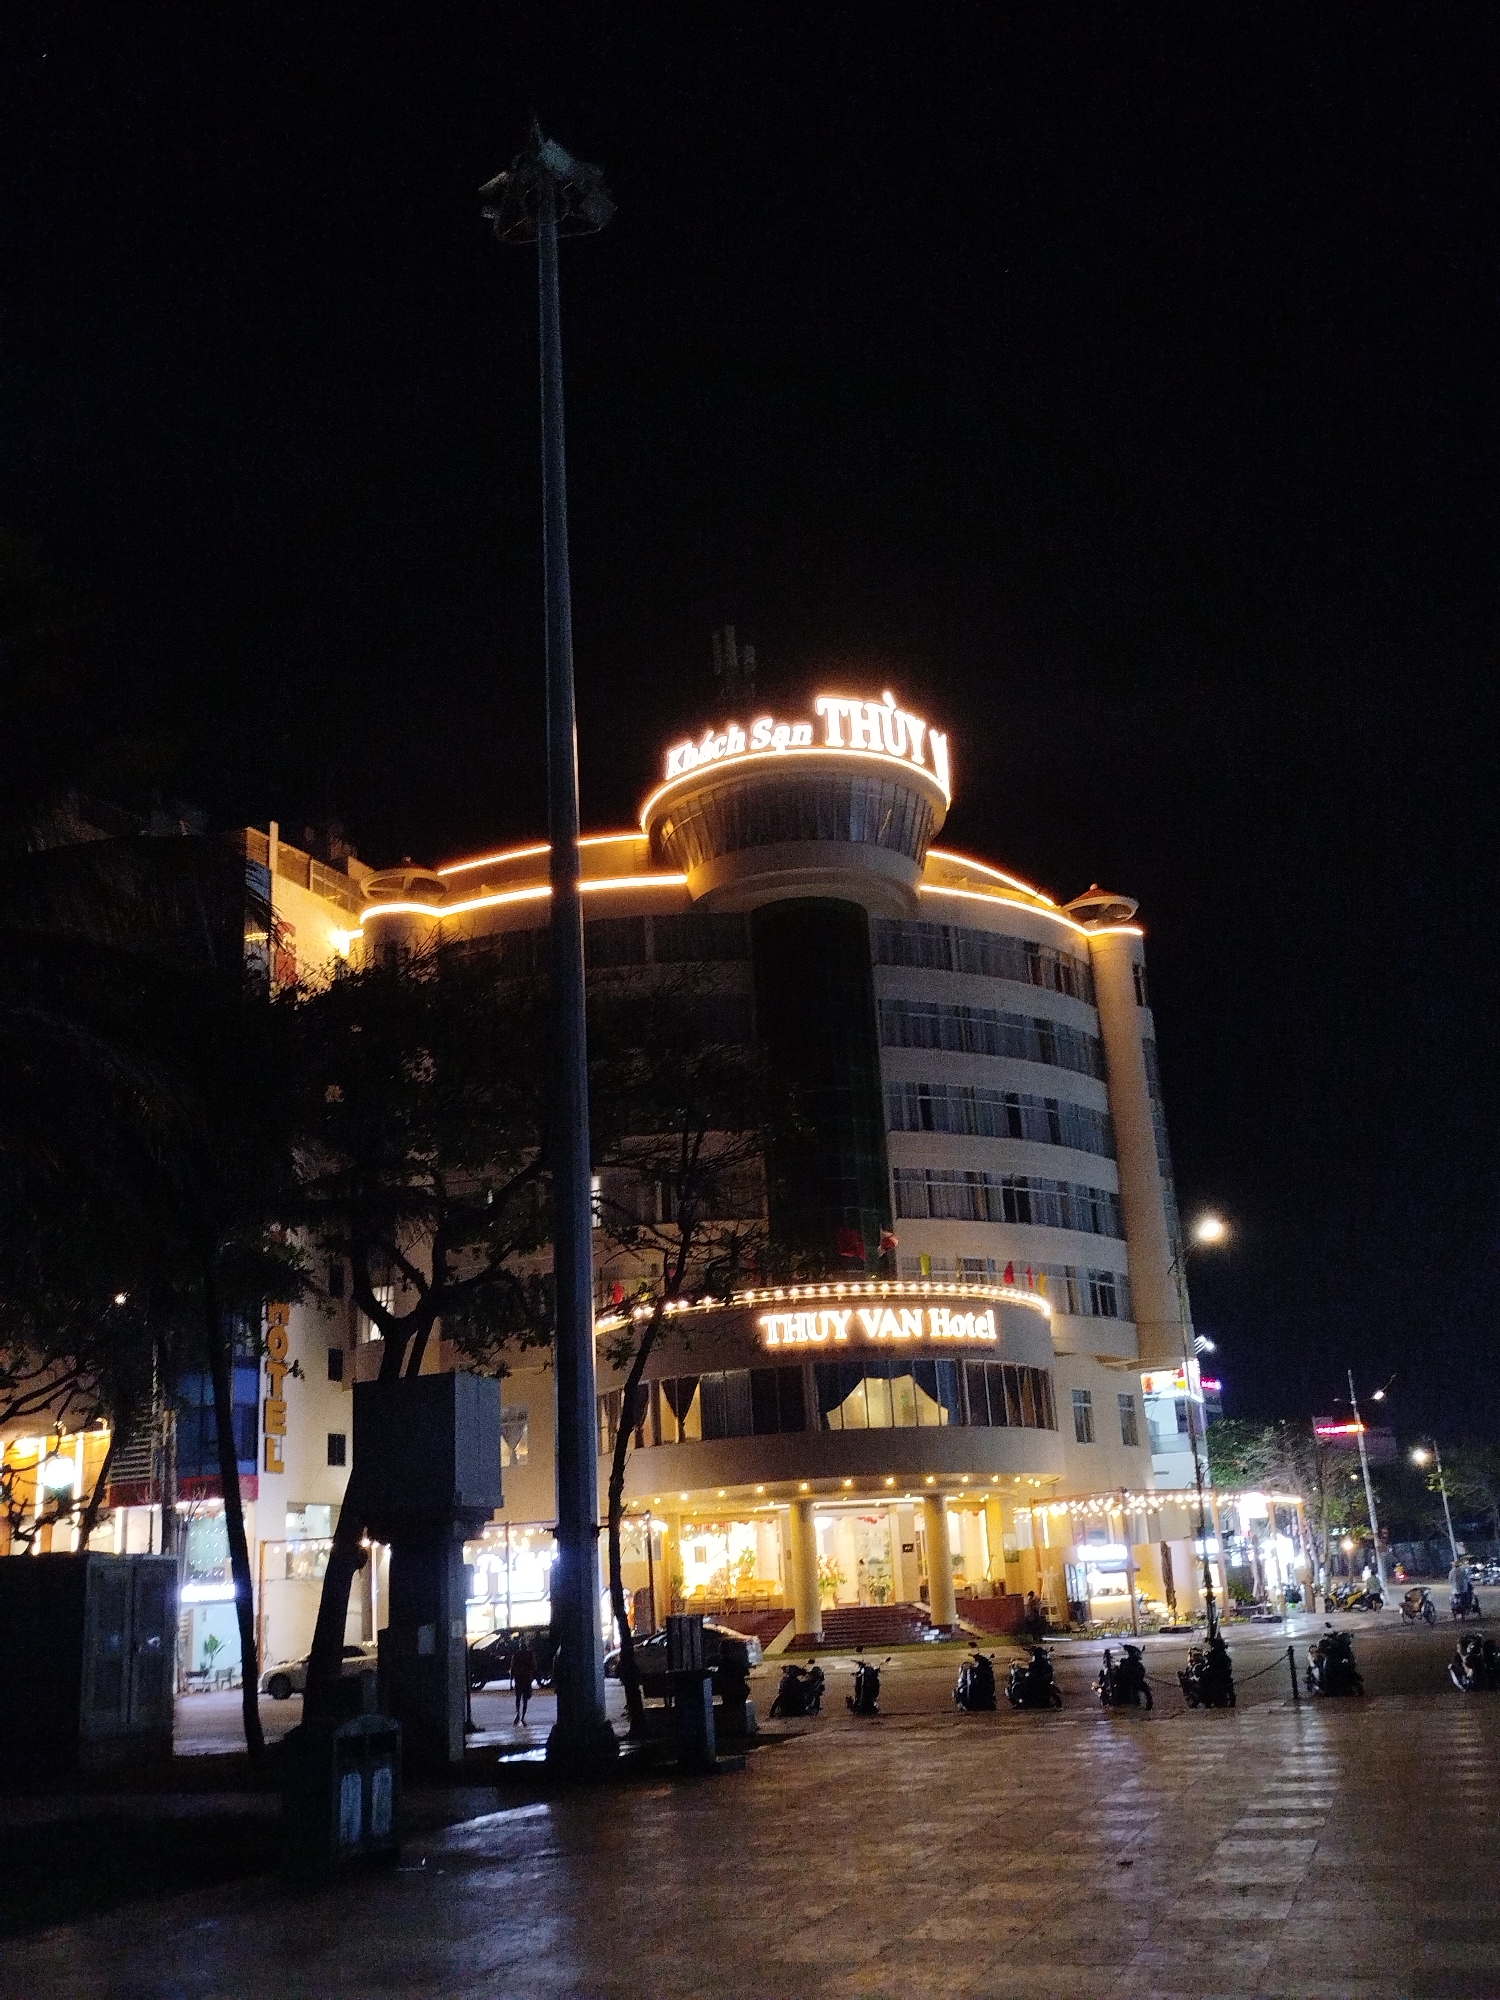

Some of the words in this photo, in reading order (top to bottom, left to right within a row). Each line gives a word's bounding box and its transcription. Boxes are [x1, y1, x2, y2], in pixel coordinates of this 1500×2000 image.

[759, 1309, 852, 1345] THUY
[857, 1308, 924, 1340] VAN
[928, 1308, 997, 1341] Hotel
